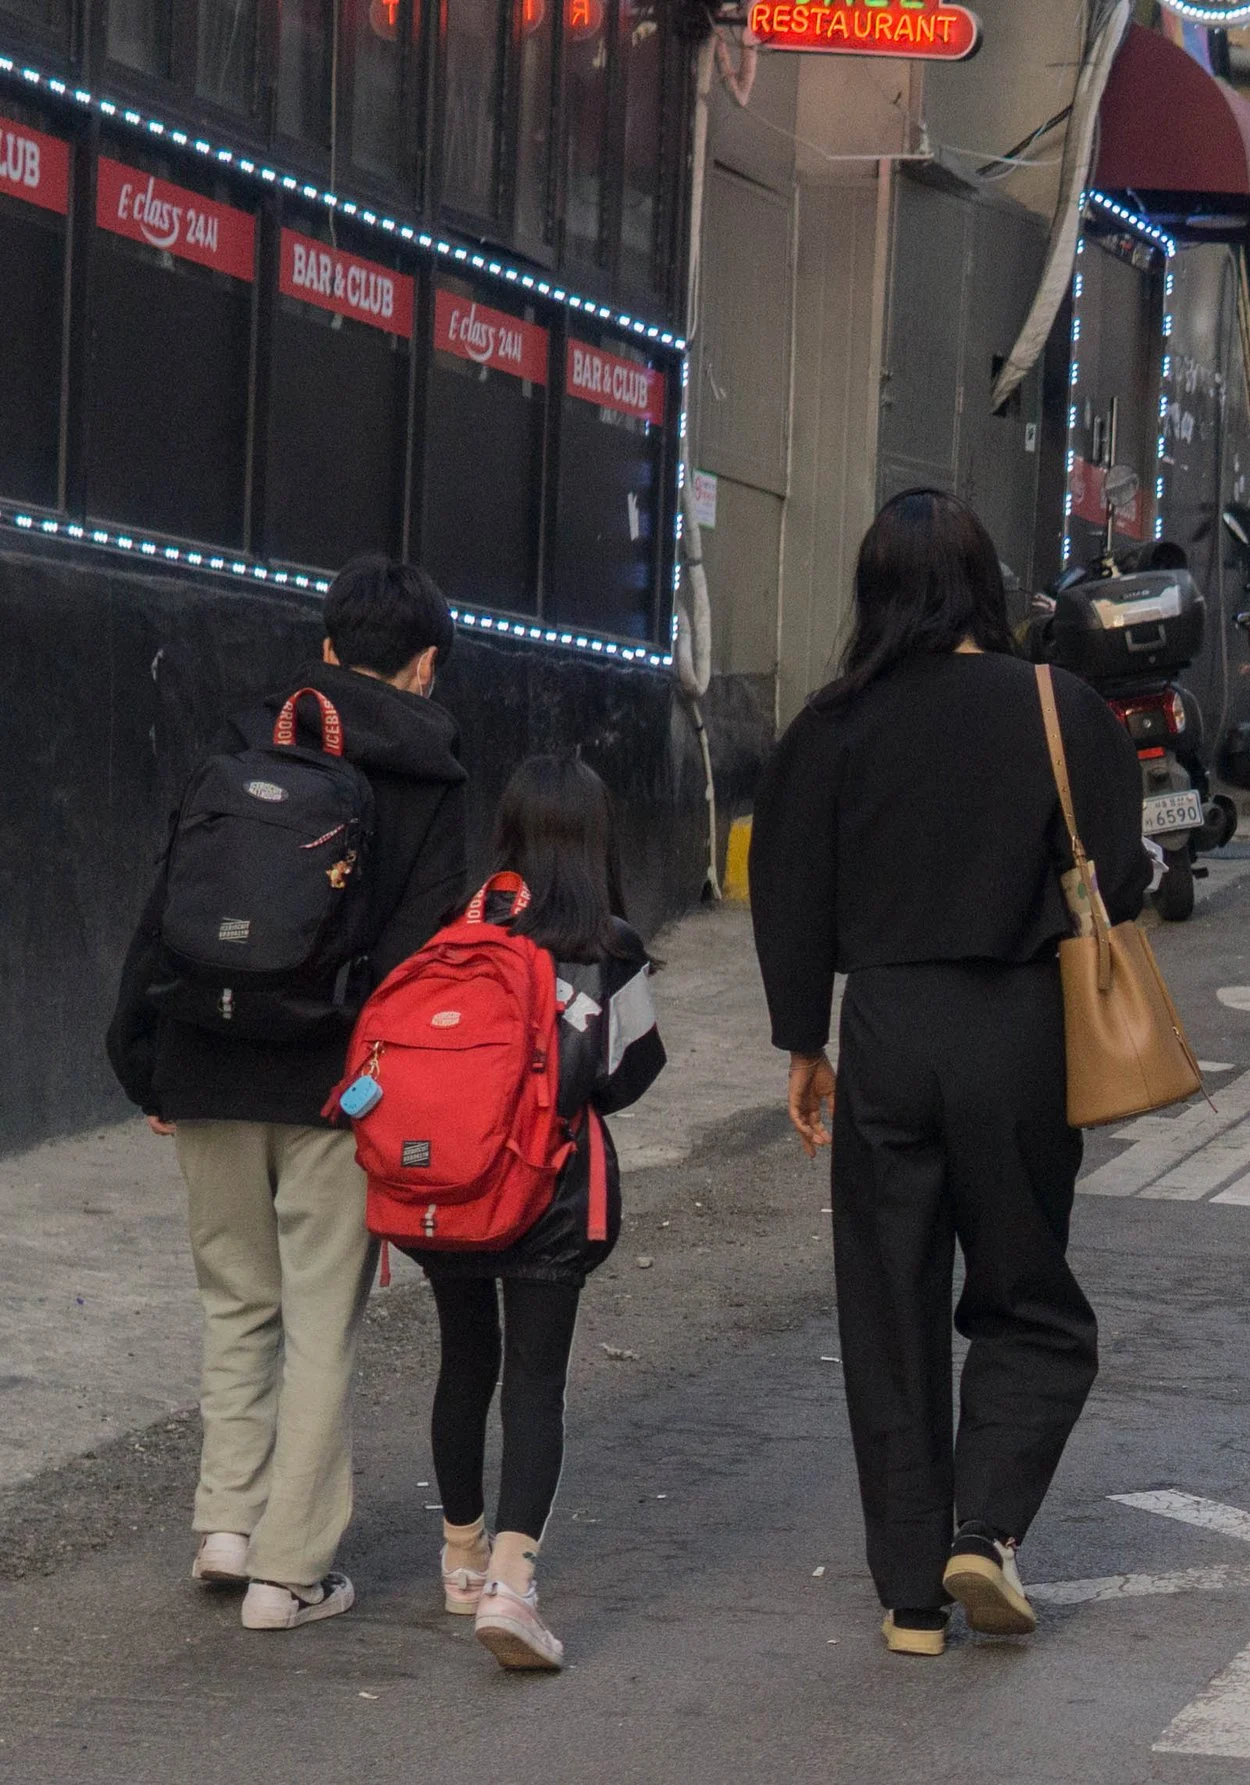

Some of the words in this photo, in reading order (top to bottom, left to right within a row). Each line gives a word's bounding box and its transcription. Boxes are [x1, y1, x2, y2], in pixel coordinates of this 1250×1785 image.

[751, 4, 958, 43] RESTAURANT
[292, 243, 332, 295] BAR
[334, 262, 345, 299] &
[347, 265, 394, 318] CLUB
[573, 349, 600, 392] BAR
[603, 362, 612, 394] &
[612, 365, 648, 409] CLUB
[1156, 806, 1197, 826] 6590
